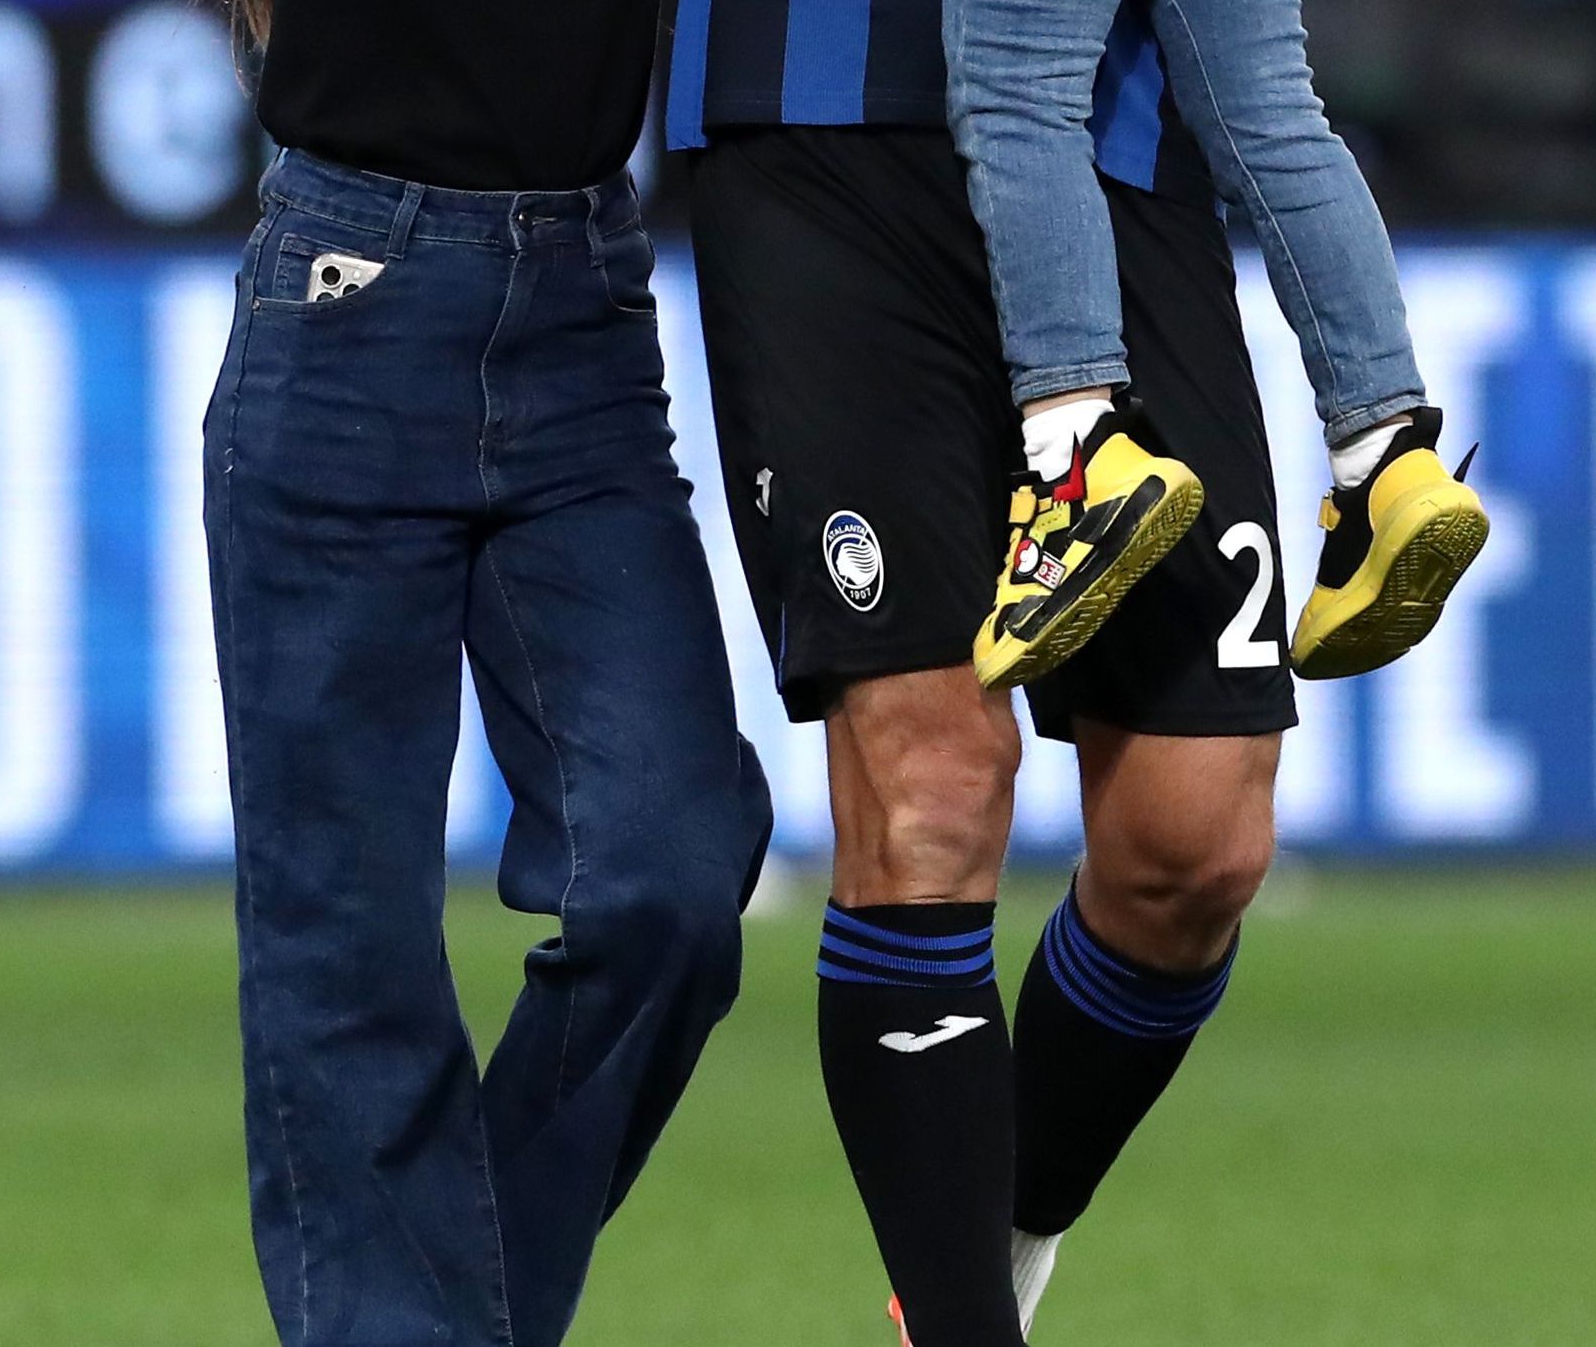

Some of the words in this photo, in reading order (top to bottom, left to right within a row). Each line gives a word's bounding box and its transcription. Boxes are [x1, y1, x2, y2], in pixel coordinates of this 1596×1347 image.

[827, 524, 867, 543] ATALANTA
[849, 588, 871, 600] 1907
[1217, 520, 1280, 669] 2
